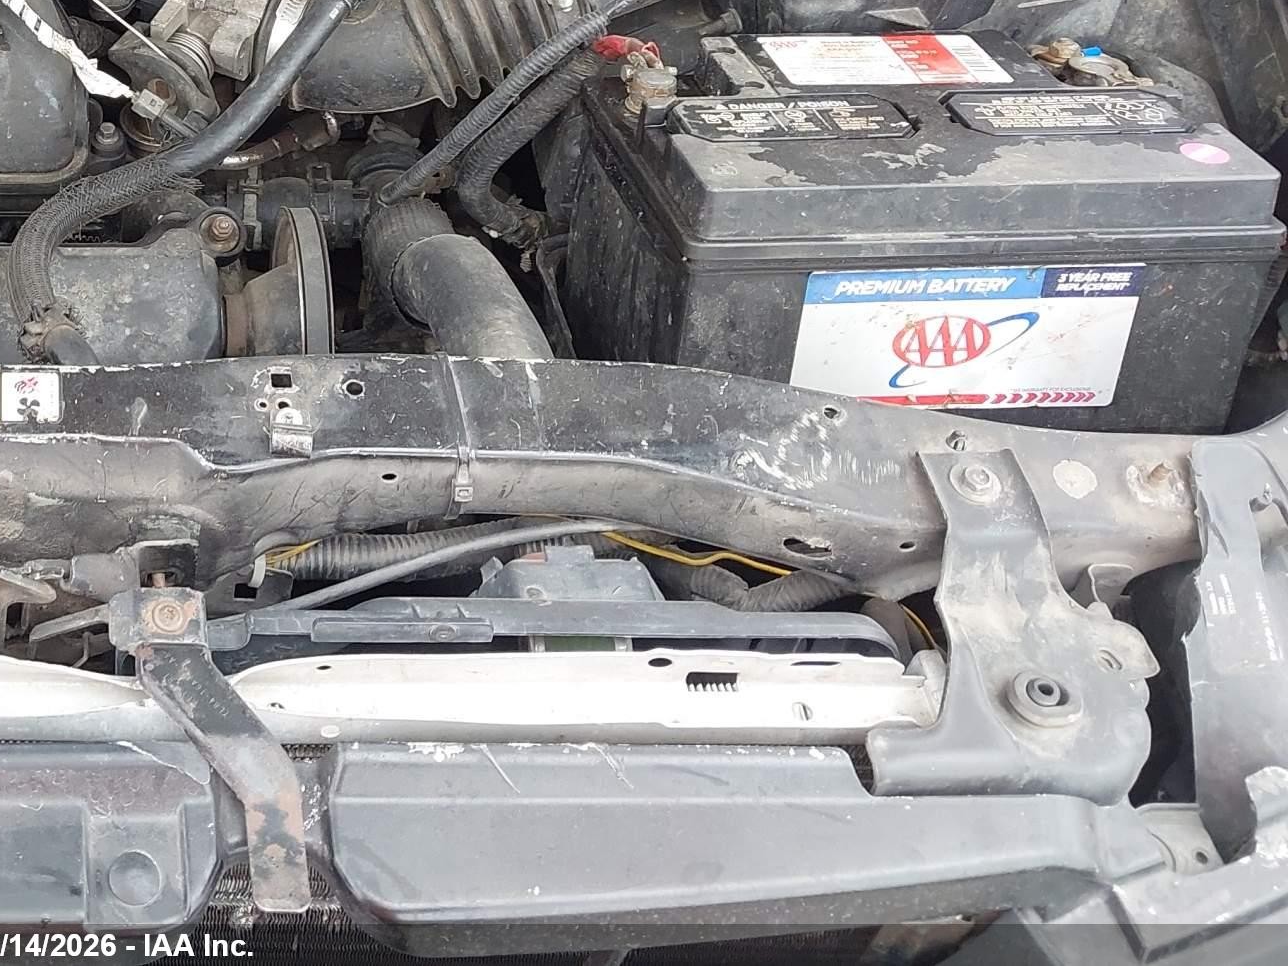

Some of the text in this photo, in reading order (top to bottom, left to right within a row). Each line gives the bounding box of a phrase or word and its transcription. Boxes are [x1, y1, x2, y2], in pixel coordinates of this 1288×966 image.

[728, 102, 786, 110] DANGER
[797, 100, 850, 108] POISON
[1057, 271, 1133, 283] 3 YEAR FREE
[835, 277, 1017, 296] PREMIUM BATTERY
[898, 316, 987, 366] AAA
